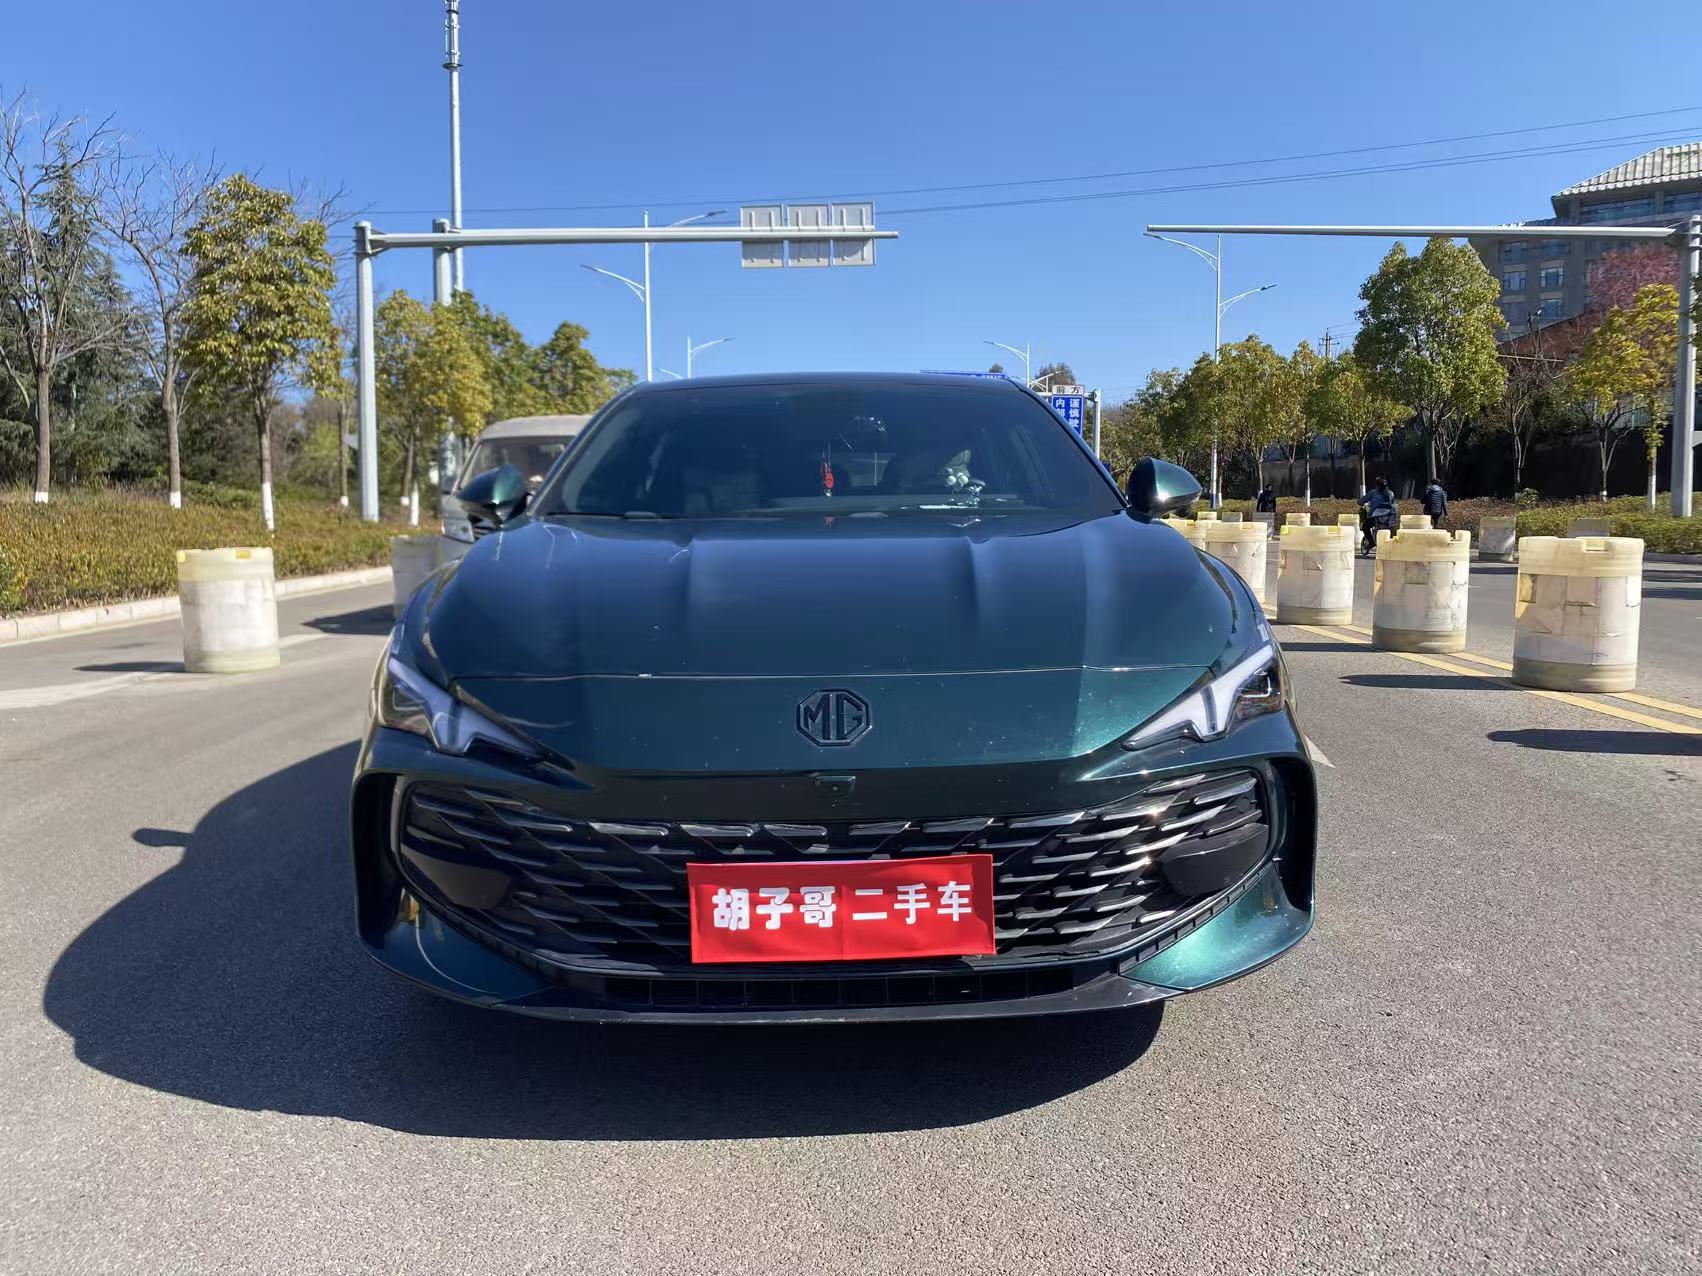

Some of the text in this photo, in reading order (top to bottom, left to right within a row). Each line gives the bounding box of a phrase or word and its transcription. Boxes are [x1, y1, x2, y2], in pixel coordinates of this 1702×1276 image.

[1056, 385, 1081, 394] 前方
[802, 692, 864, 741] MG
[712, 881, 972, 931] 胡子哥 二手车
